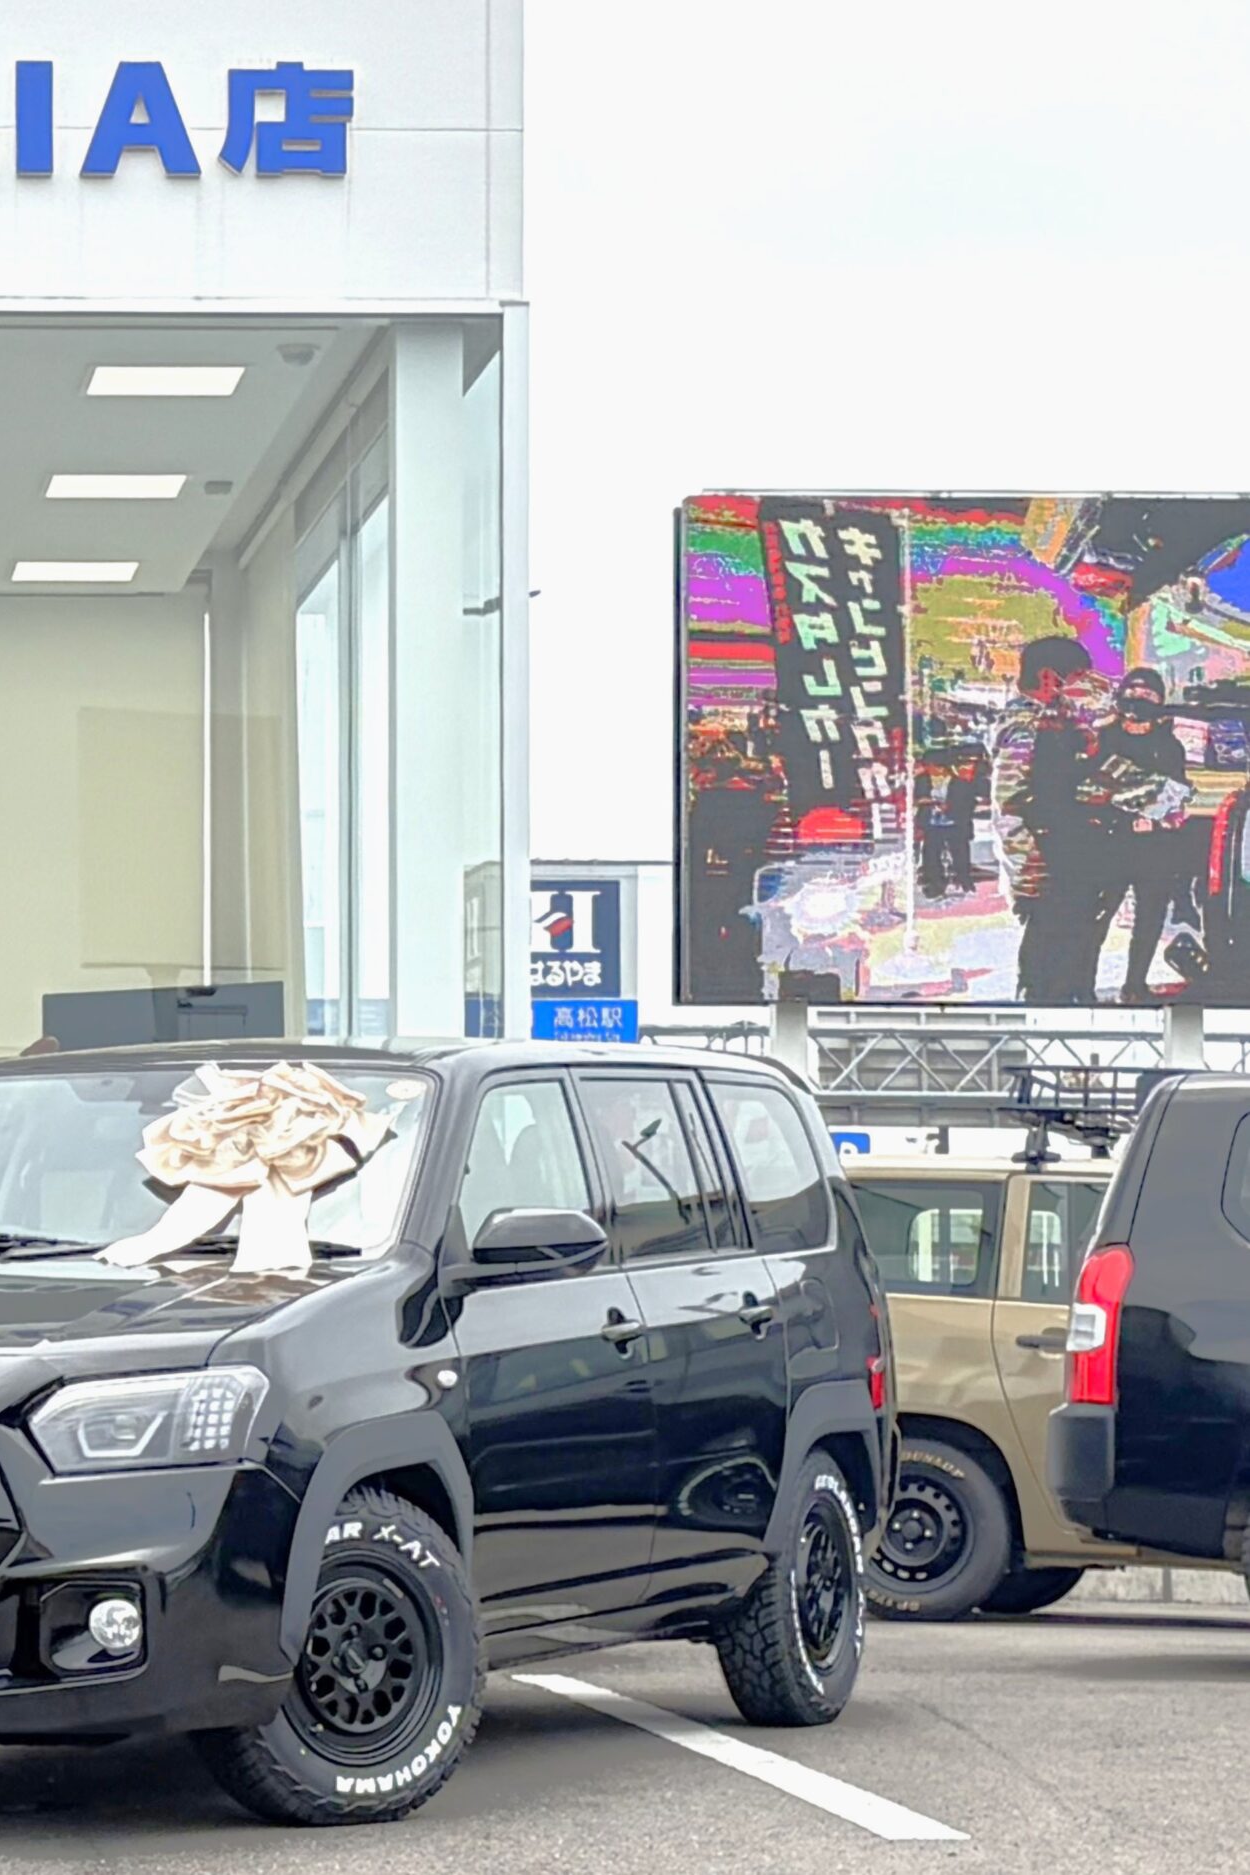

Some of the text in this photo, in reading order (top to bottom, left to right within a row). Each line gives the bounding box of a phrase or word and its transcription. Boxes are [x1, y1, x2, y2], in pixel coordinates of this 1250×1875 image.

[530, 959, 602, 987] はるやま
[554, 1006, 623, 1029] 高松駅
[373, 1524, 441, 1567] X-AT
[336, 1704, 462, 1793] YOKOHAMA
